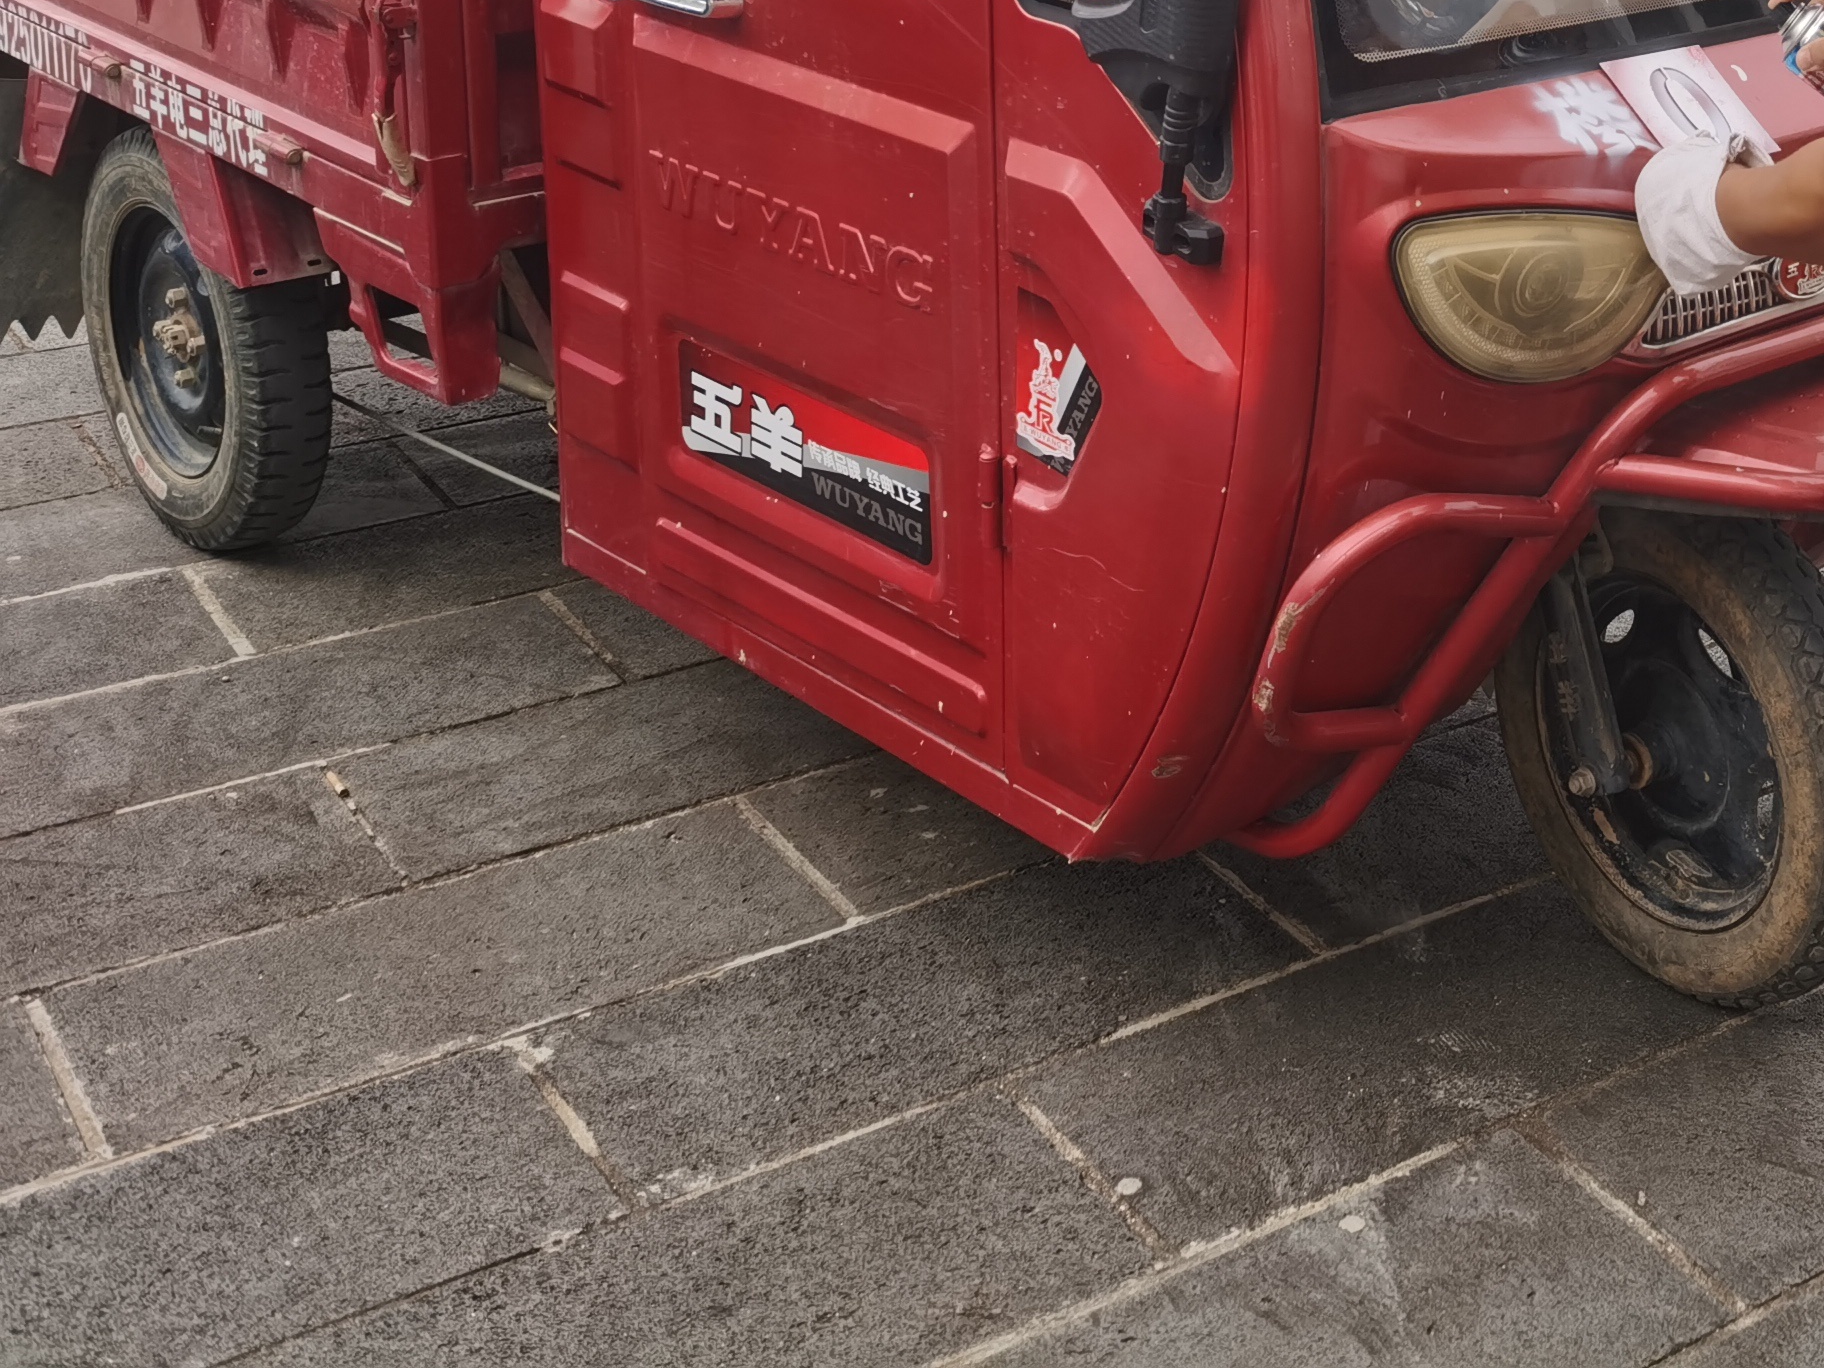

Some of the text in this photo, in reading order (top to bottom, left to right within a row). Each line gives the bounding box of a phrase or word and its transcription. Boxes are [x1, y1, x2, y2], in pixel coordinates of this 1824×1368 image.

[130, 59, 268, 177] 五羊电三总代理
[649, 150, 933, 312] WUYANG
[690, 370, 803, 478] 五羊
[807, 439, 924, 512] 传承品牌 经典工艺
[1050, 376, 1099, 474] WYANG
[811, 472, 923, 545] WUYANG
